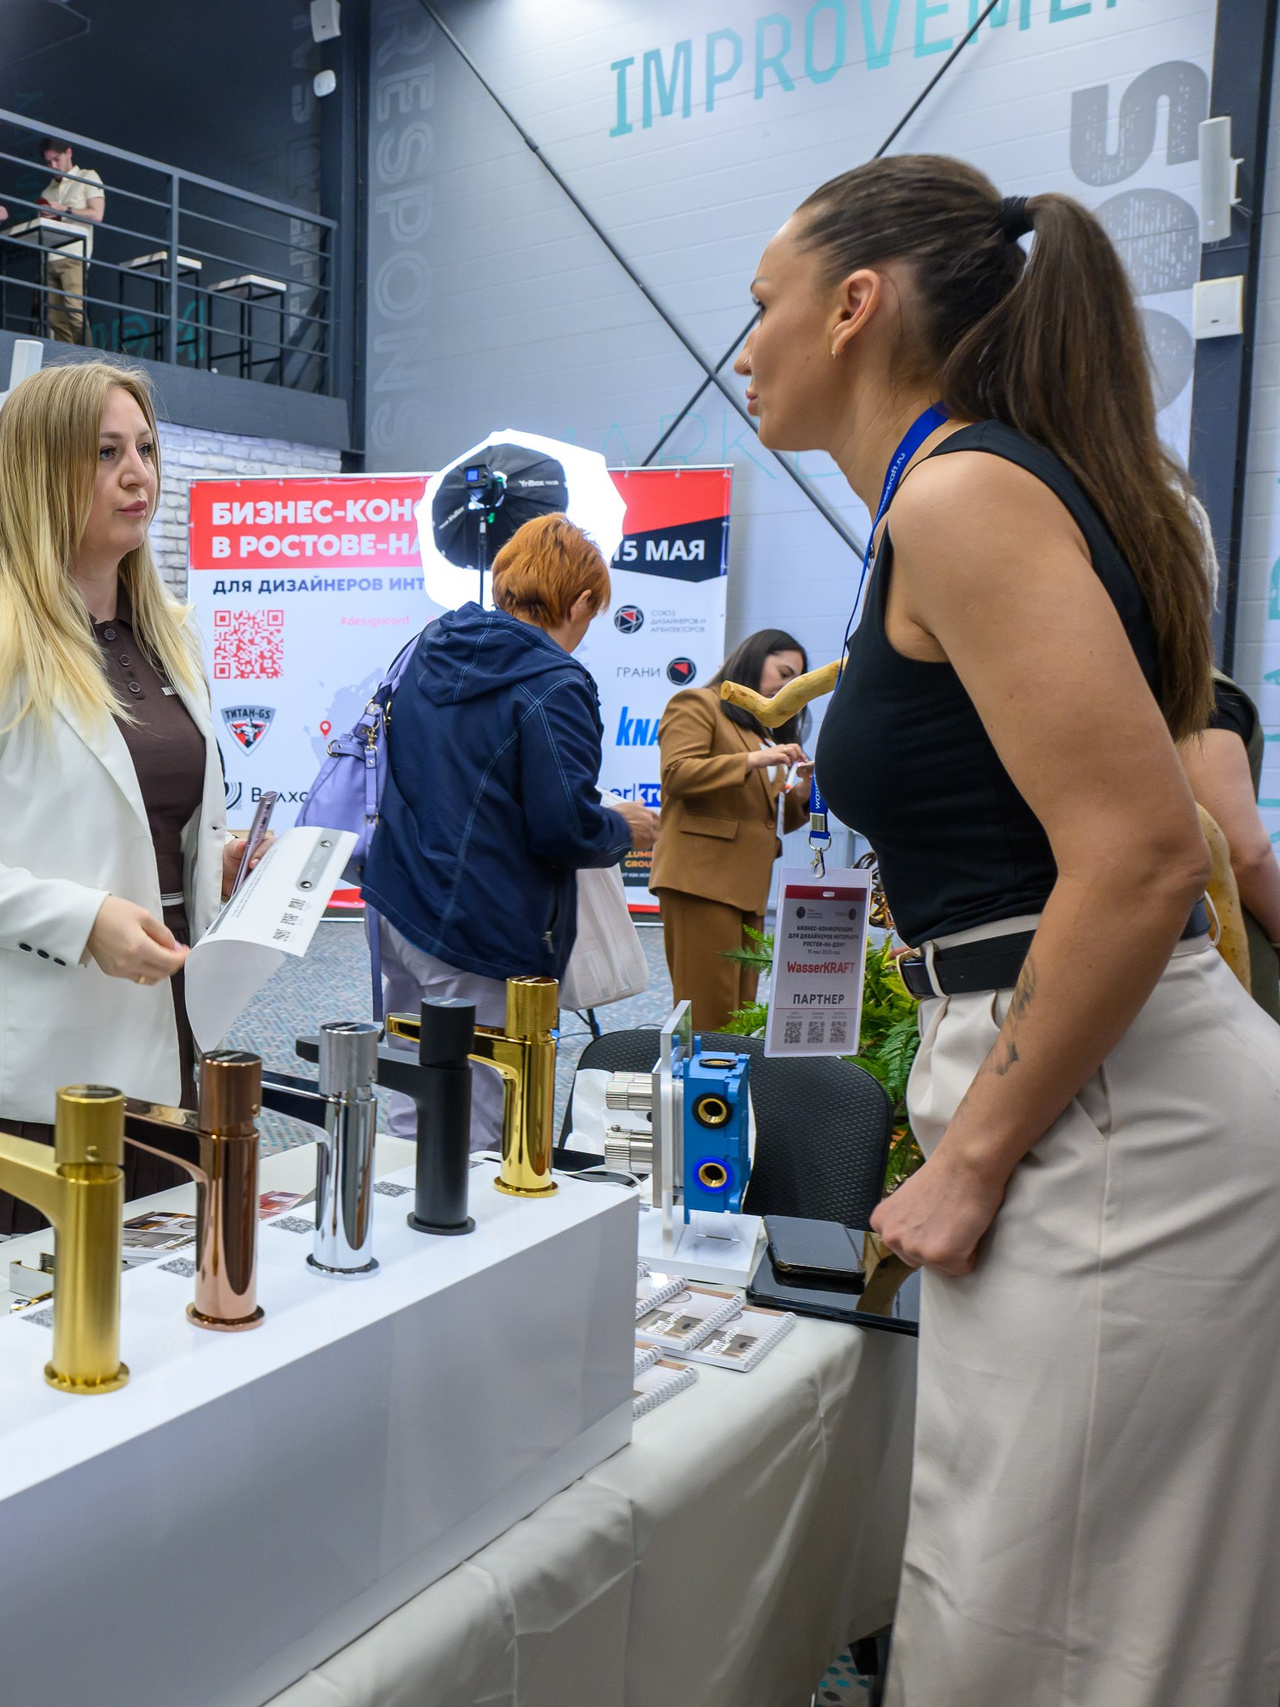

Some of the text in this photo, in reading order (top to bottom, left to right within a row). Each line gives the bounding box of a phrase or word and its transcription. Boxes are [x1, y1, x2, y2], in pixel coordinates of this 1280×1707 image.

[609, 0, 1116, 139] IMPROVE
[212, 536, 231, 558] В
[645, 539, 706, 561] МАЯ
[213, 580, 252, 595] ДЛЯ
[258, 575, 383, 595] ДИЗАЙНЕРОВ
[340, 615, 410, 628] #designconf
[616, 667, 661, 677] ГРАНИ
[224, 708, 271, 719] ТИТАН-GS
[787, 961, 856, 974] WasserKRAFT
[793, 994, 845, 1005] ПАРТНЕР
